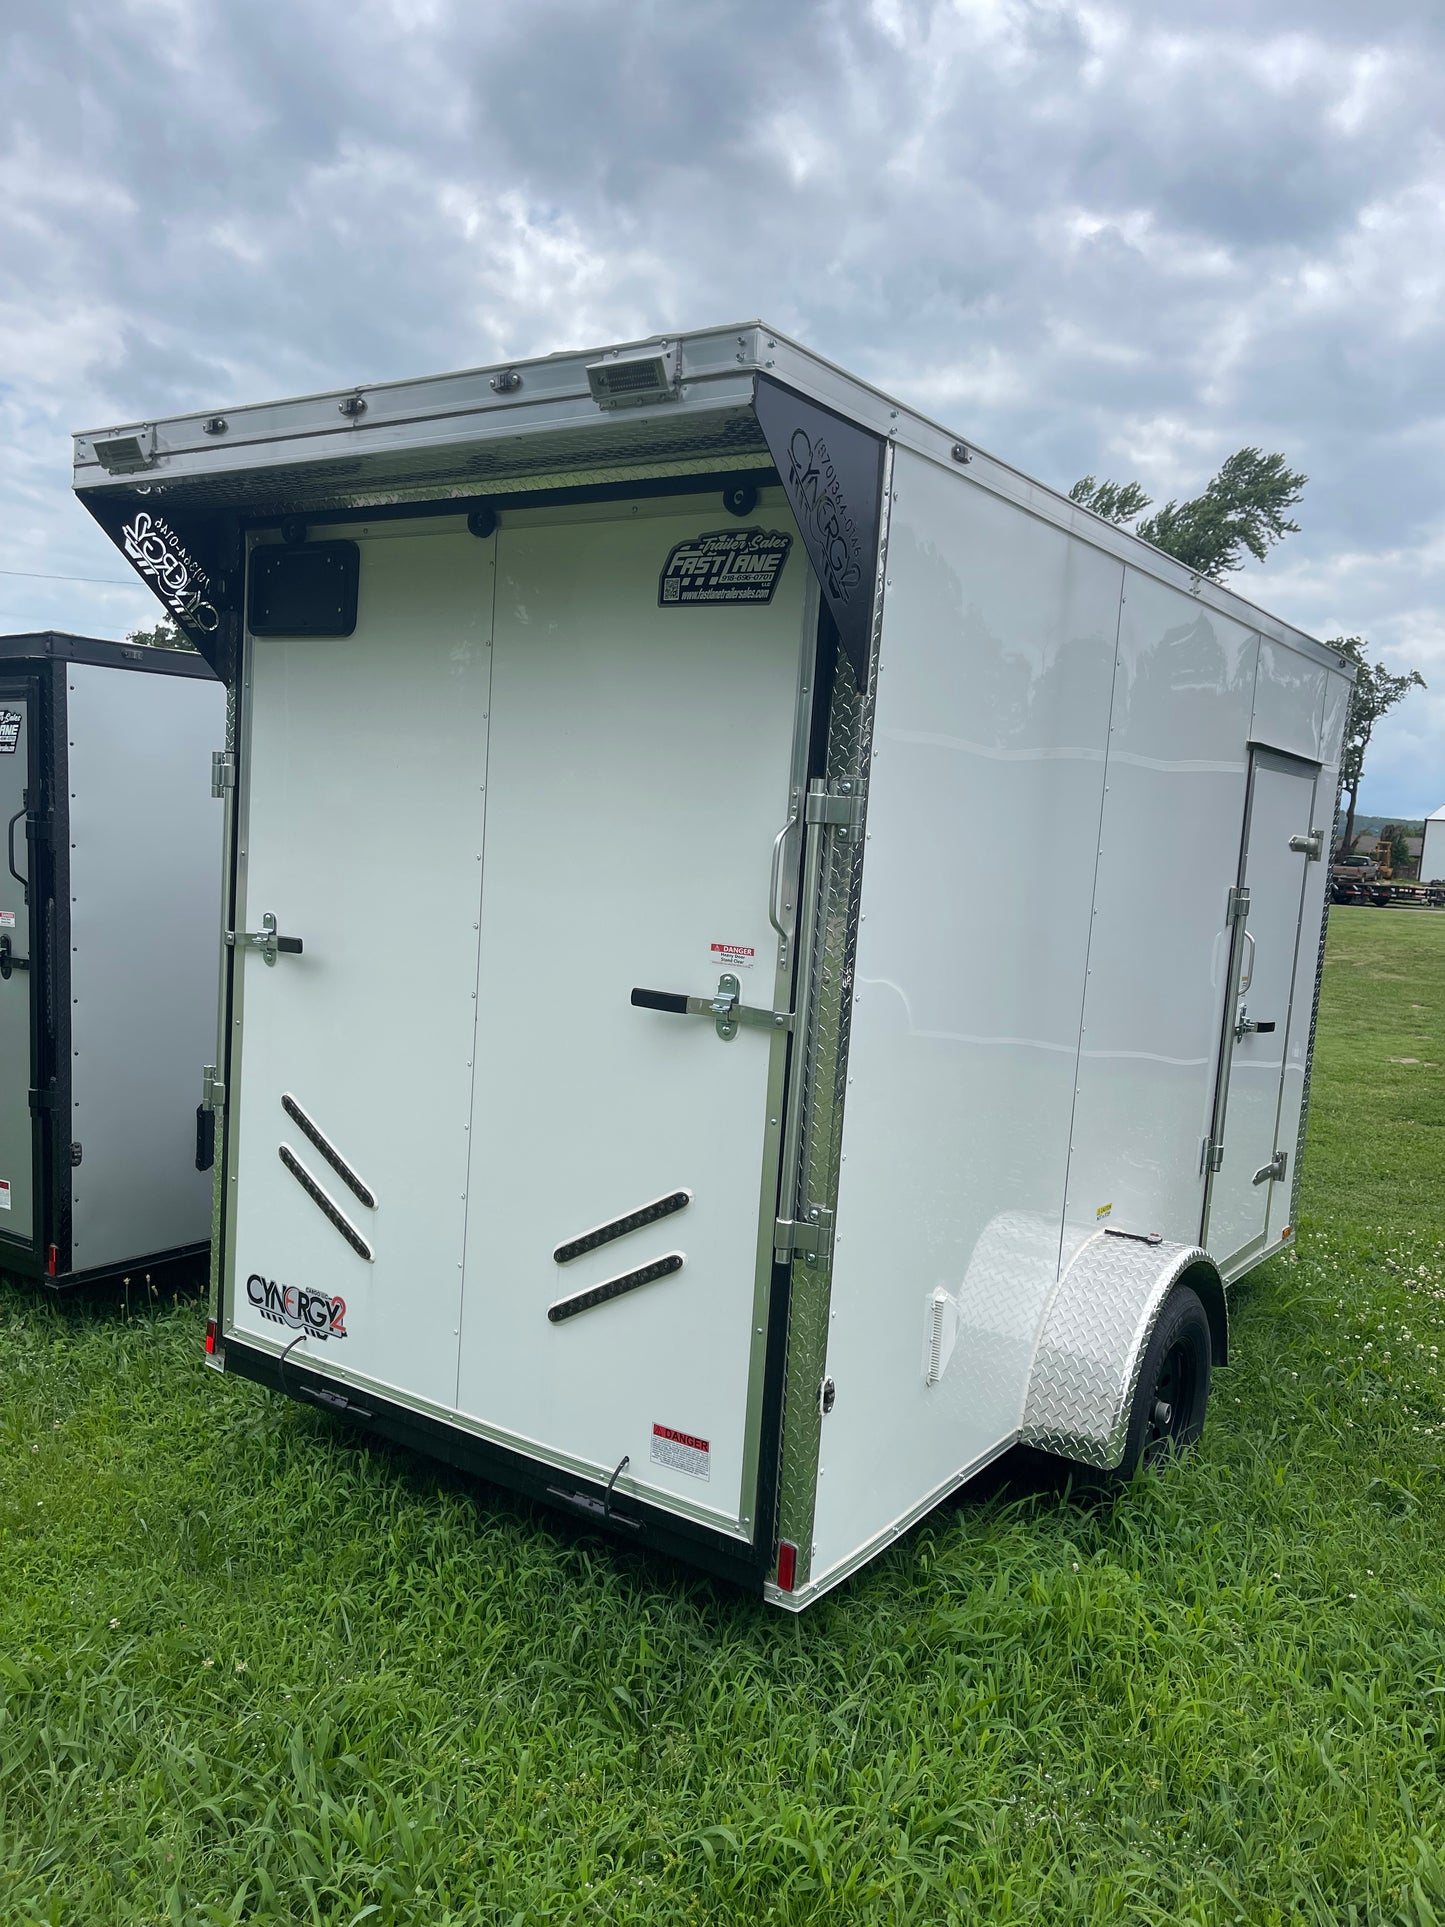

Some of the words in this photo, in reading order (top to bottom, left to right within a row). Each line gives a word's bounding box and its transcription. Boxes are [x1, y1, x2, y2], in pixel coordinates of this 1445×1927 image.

[701, 537, 746, 553] Trailer
[748, 534, 789, 551] Sales
[0, 724, 19, 735] ANE
[723, 946, 752, 956] DANGER
[665, 1428, 709, 1453] DANGER
